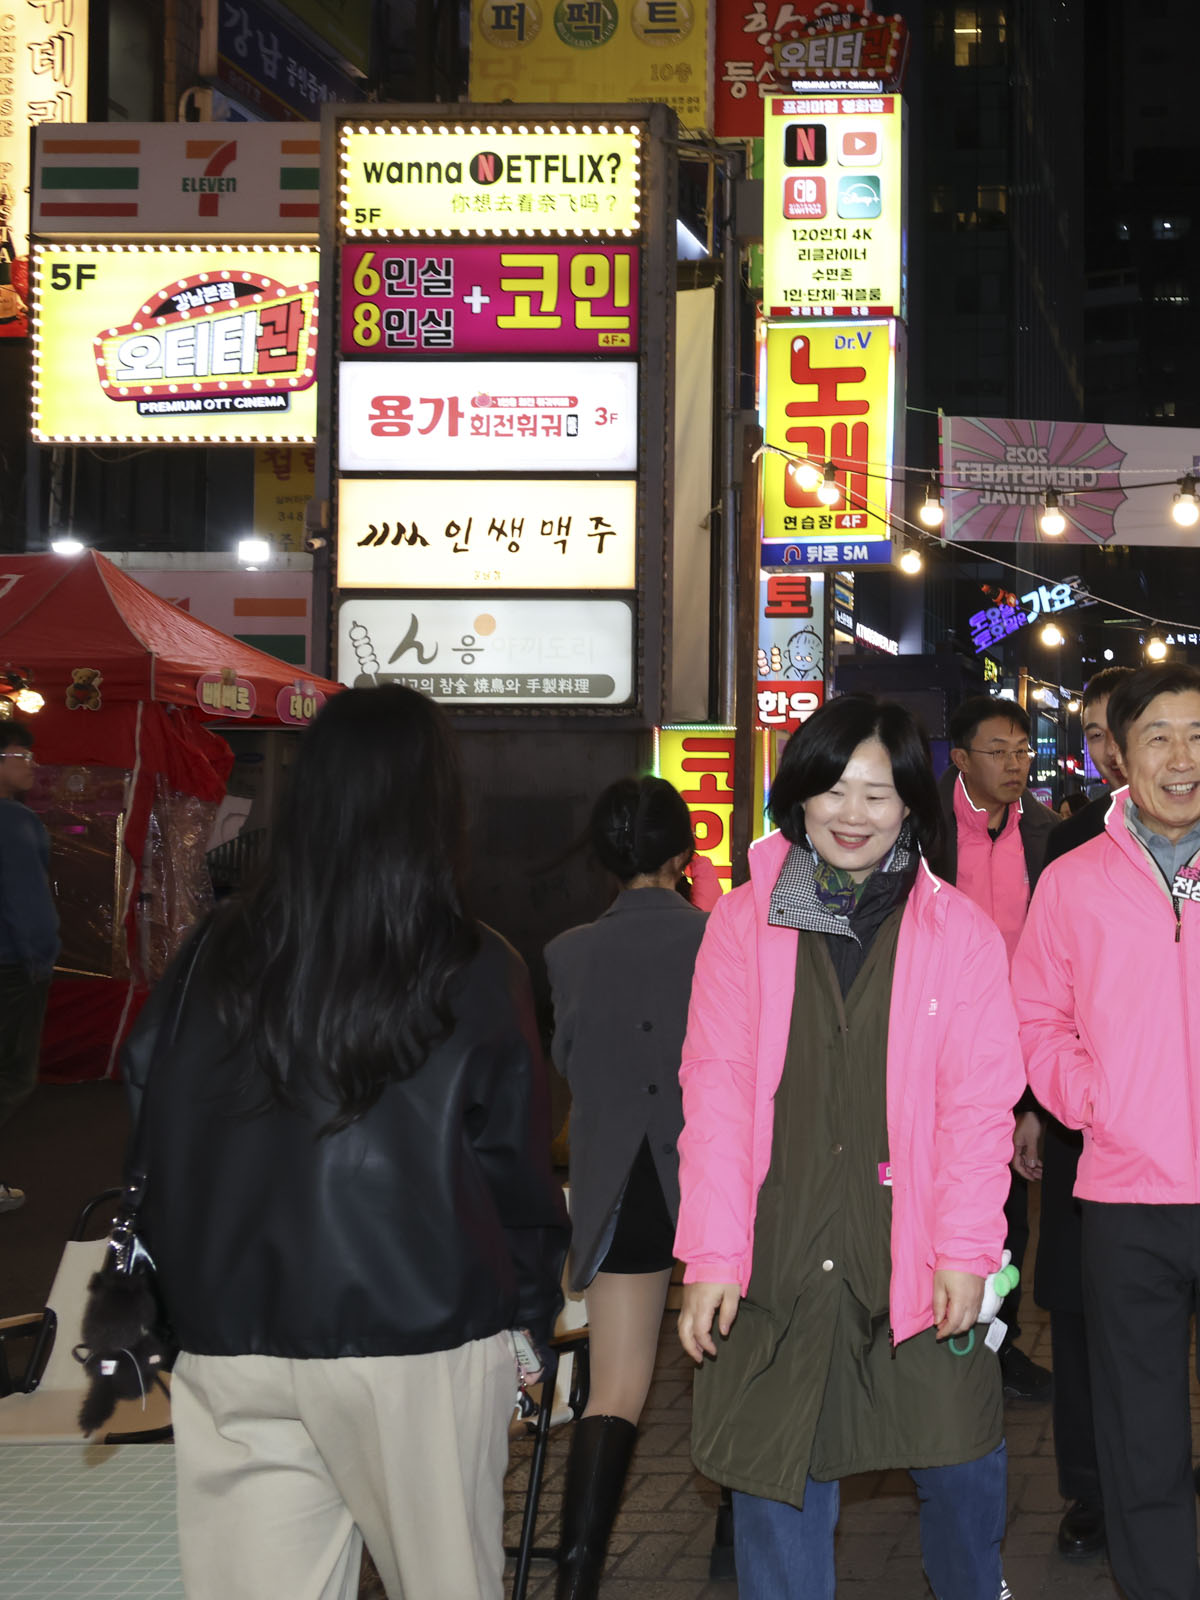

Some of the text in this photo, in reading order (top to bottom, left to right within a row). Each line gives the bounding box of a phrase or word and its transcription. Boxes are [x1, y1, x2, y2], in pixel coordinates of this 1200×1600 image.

[363, 152, 622, 184] wanna NETFLIX?
[354, 207, 381, 224] 5F
[791, 228, 873, 241] 120인치 4K
[798, 248, 867, 261] 리클라이너
[50, 263, 97, 291] 5F
[352, 252, 454, 298] 6인실
[812, 268, 853, 281] 수면존
[171, 282, 236, 311] 강남본점
[496, 252, 631, 330] 코인
[352, 302, 454, 349] 8인실
[115, 298, 305, 381] 오티티관
[602, 334, 619, 345] 4F
[834, 331, 873, 350] Dr.V
[139, 396, 286, 414] PREMIUM OTT CINEMA
[368, 394, 465, 438] 용가
[594, 406, 619, 426] 3F
[470, 414, 562, 438] 회전훠궈
[784, 335, 869, 512] 노래
[783, 514, 863, 531] 연습장 4F
[807, 545, 869, 563] 뒤로 5M
[1020, 583, 1077, 624] 가요
[757, 690, 823, 723] 한우
